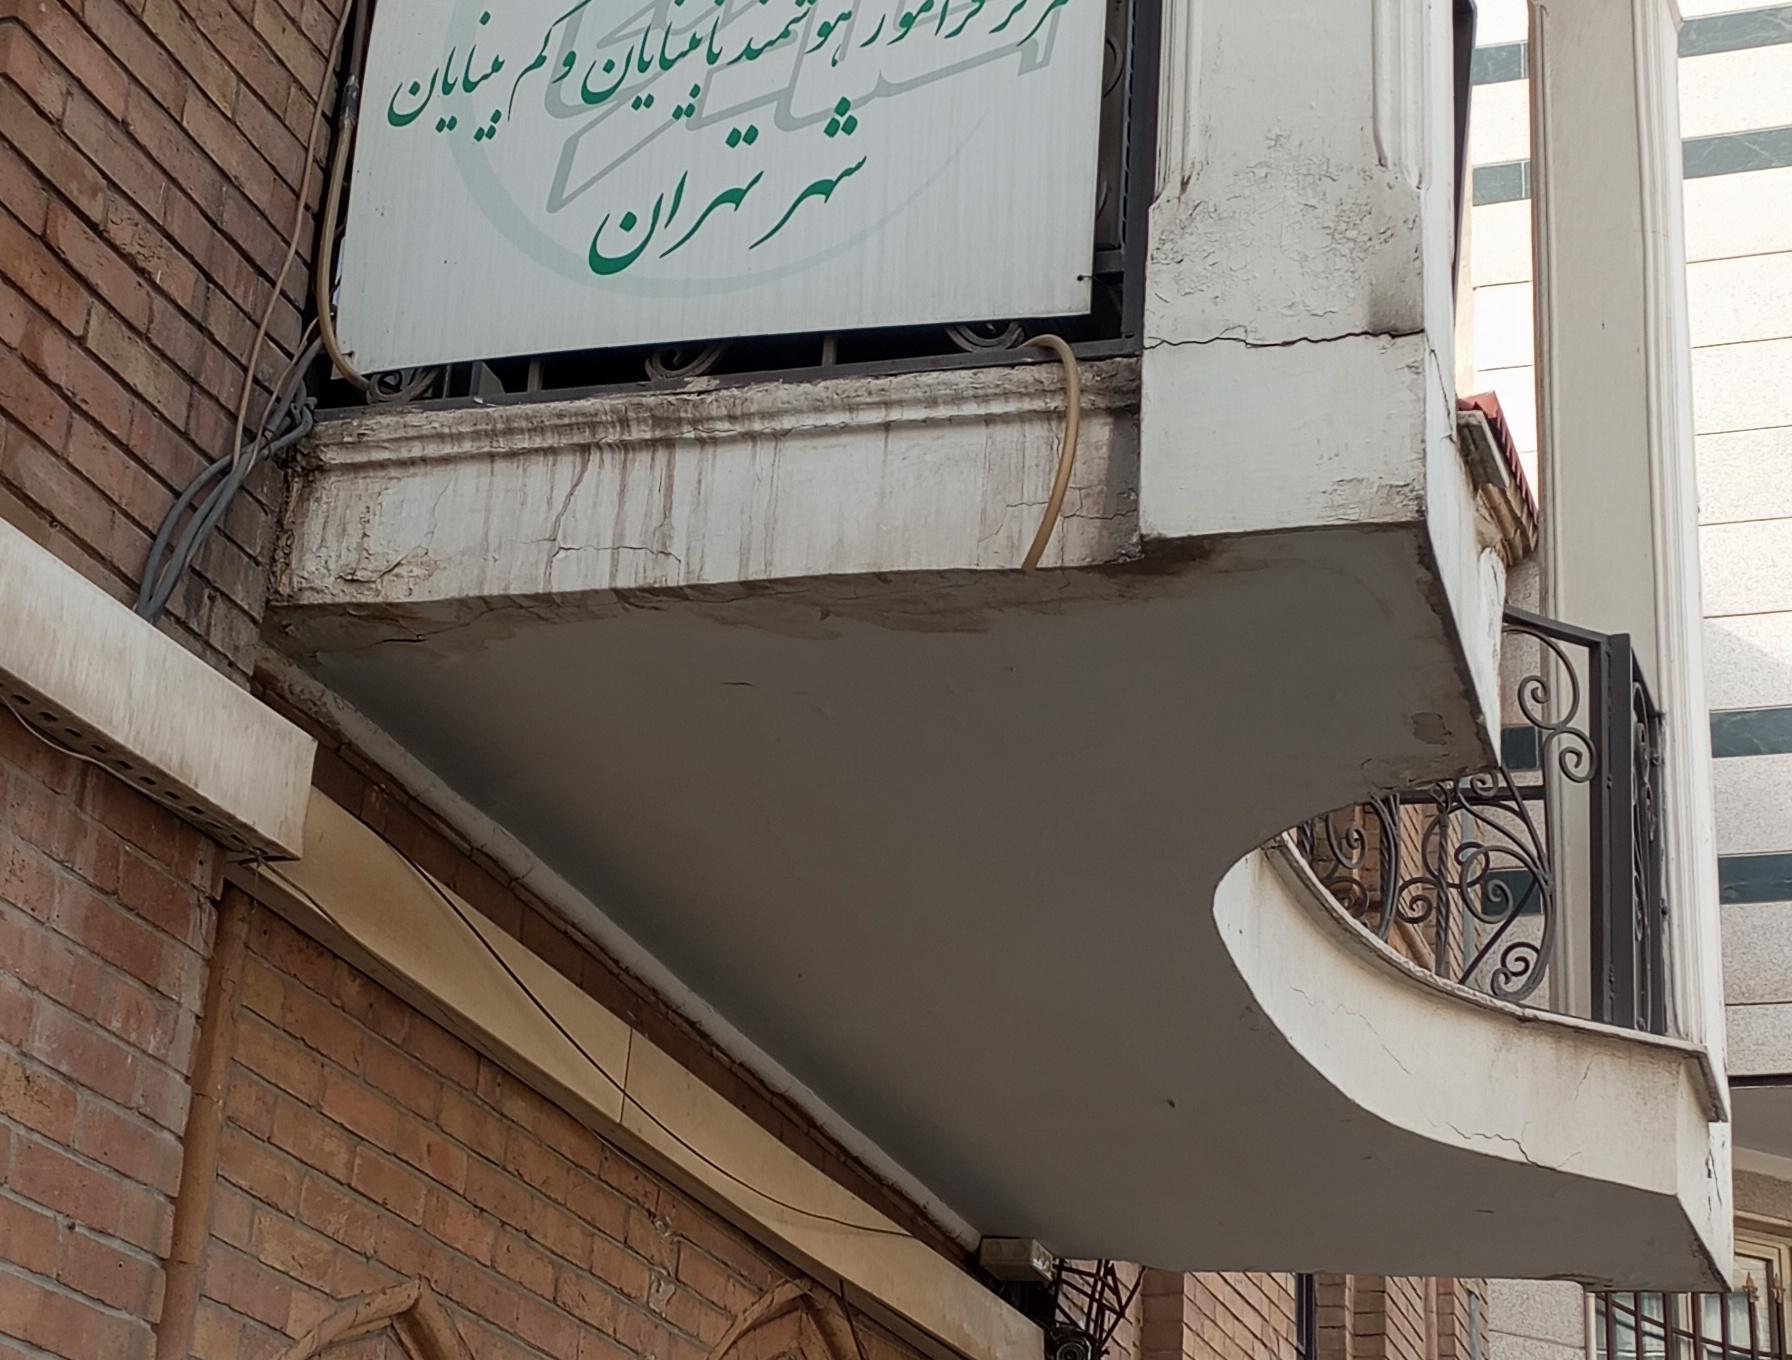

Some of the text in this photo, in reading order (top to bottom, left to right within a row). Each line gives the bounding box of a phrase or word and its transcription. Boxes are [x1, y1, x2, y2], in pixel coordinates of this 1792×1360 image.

[387, 11, 505, 142] بینایان
[551, 50, 577, 84] و
[588, 96, 867, 276] شهر تهران
